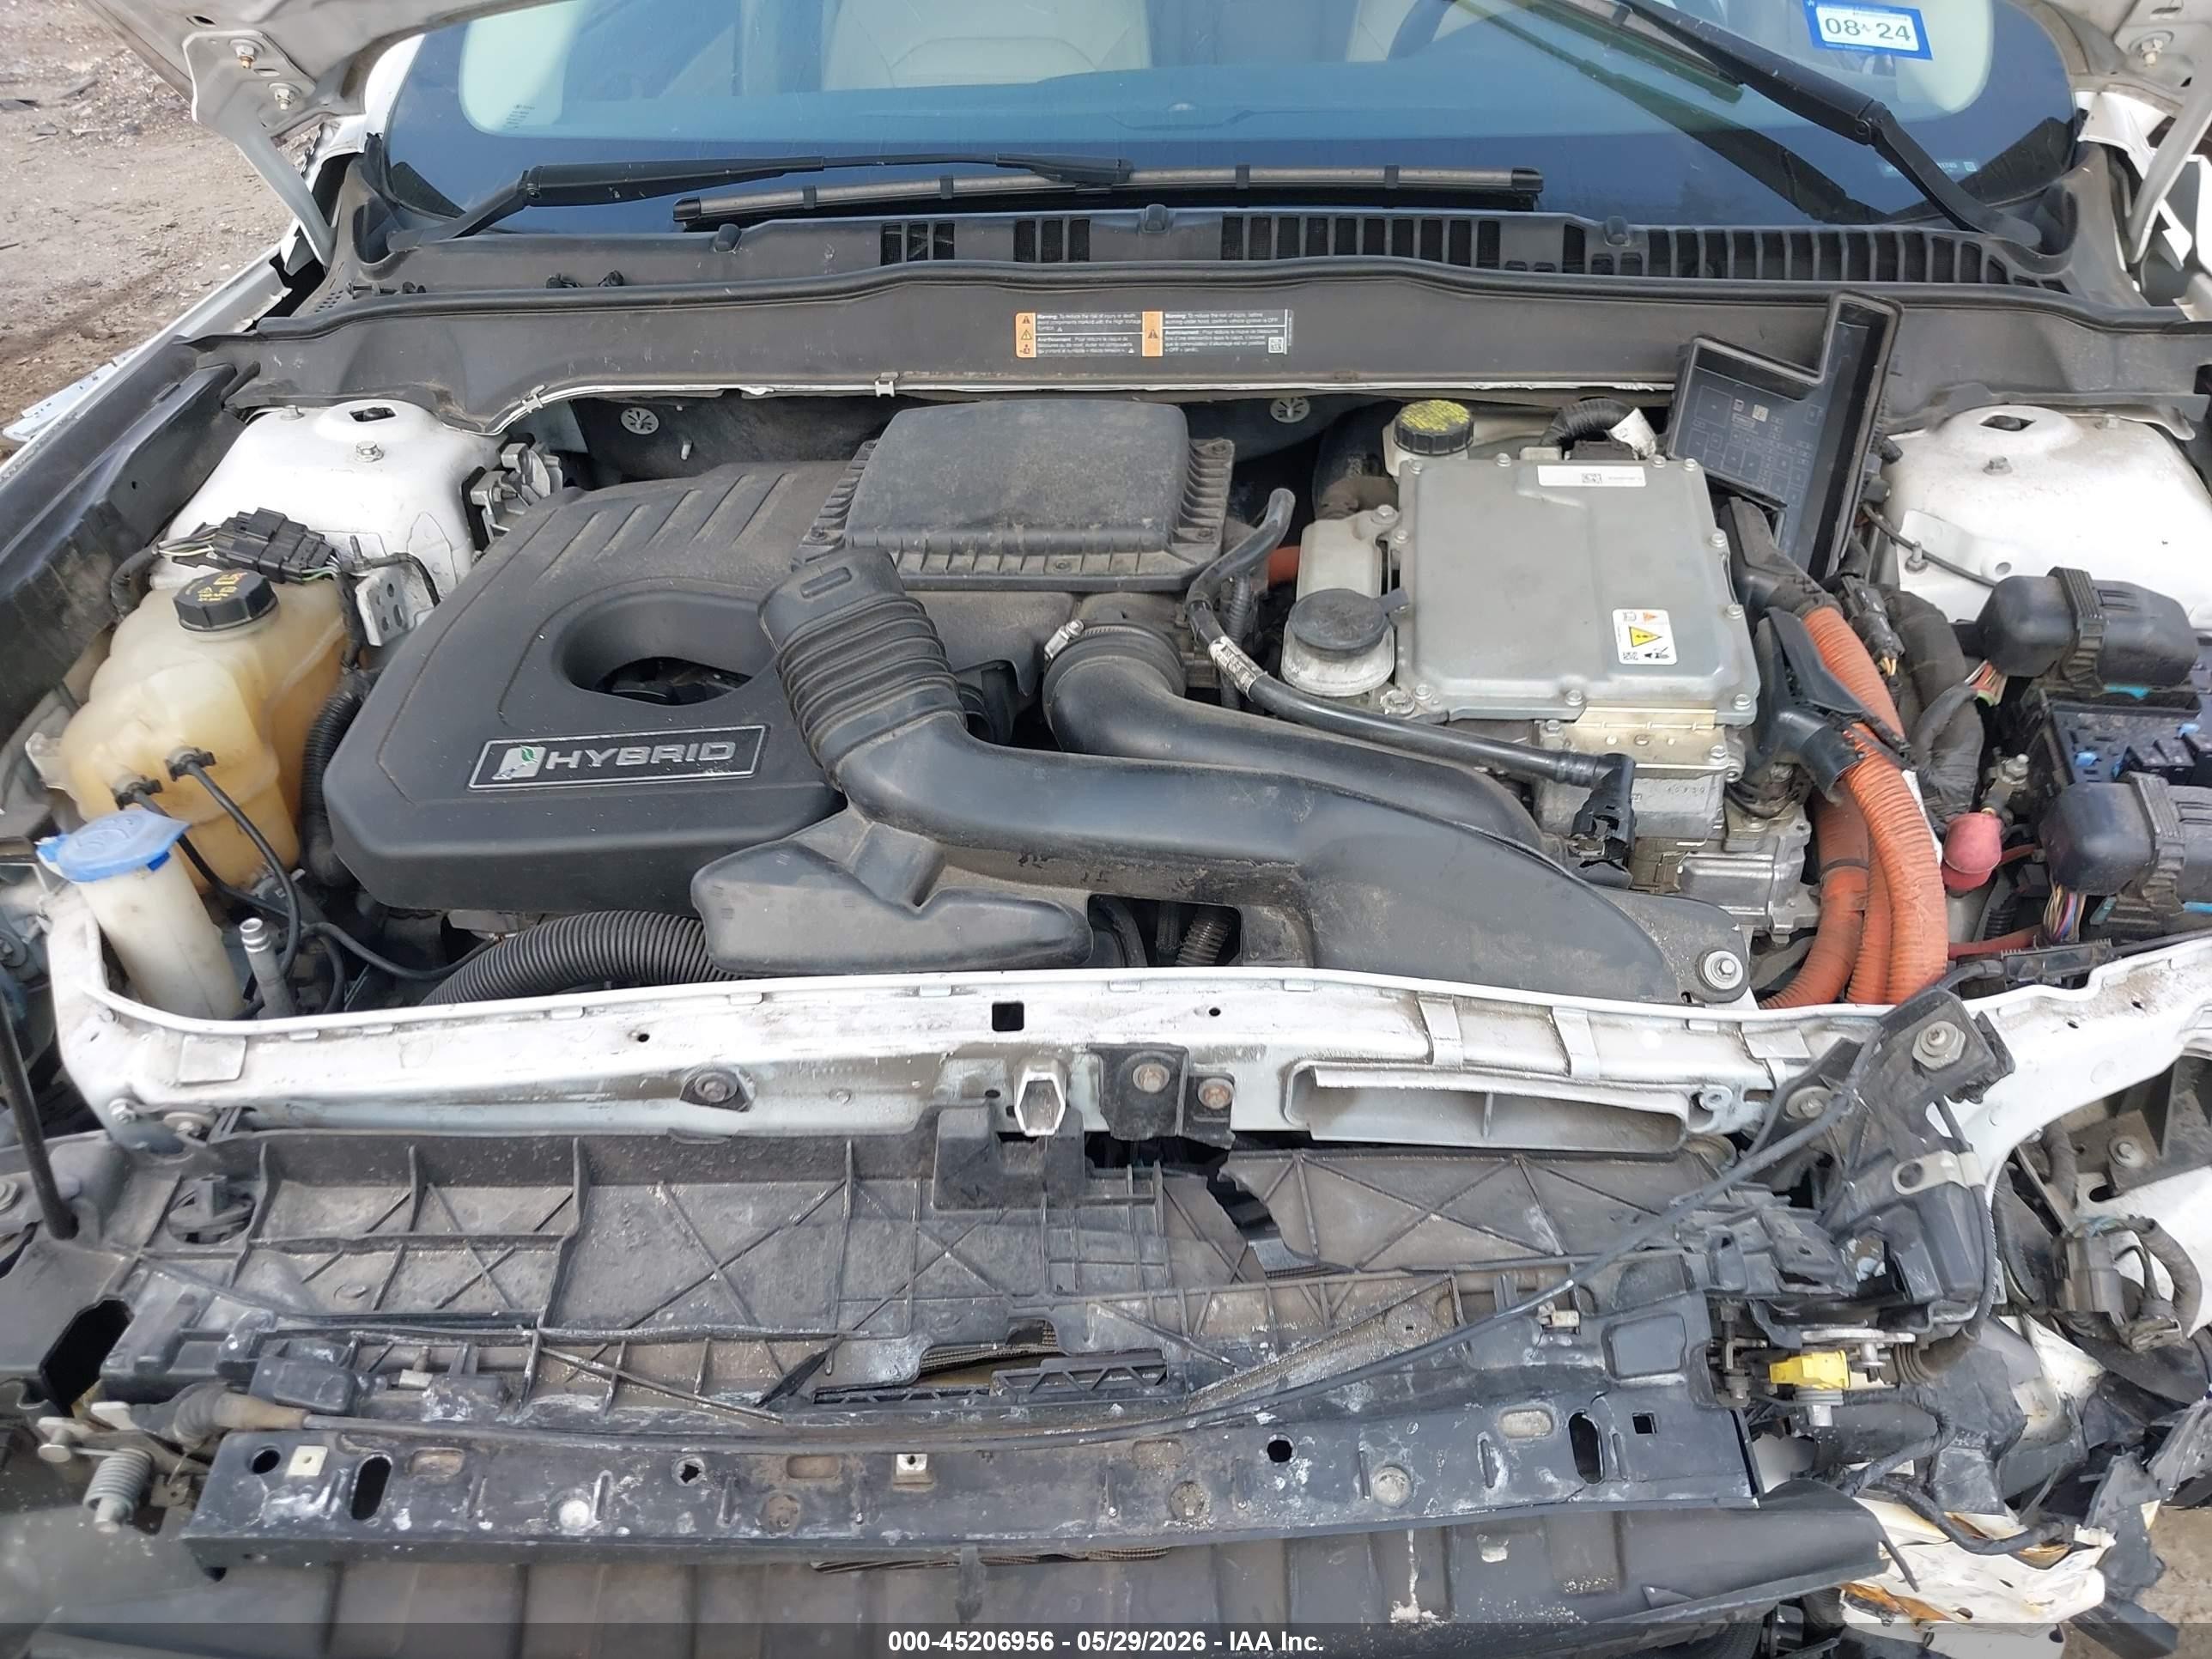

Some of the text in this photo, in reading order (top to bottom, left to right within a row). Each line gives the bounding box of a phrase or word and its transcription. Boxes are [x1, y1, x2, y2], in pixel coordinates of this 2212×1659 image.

[1825, 17, 1911, 41] 08 24
[545, 742, 736, 769] HYBRID
